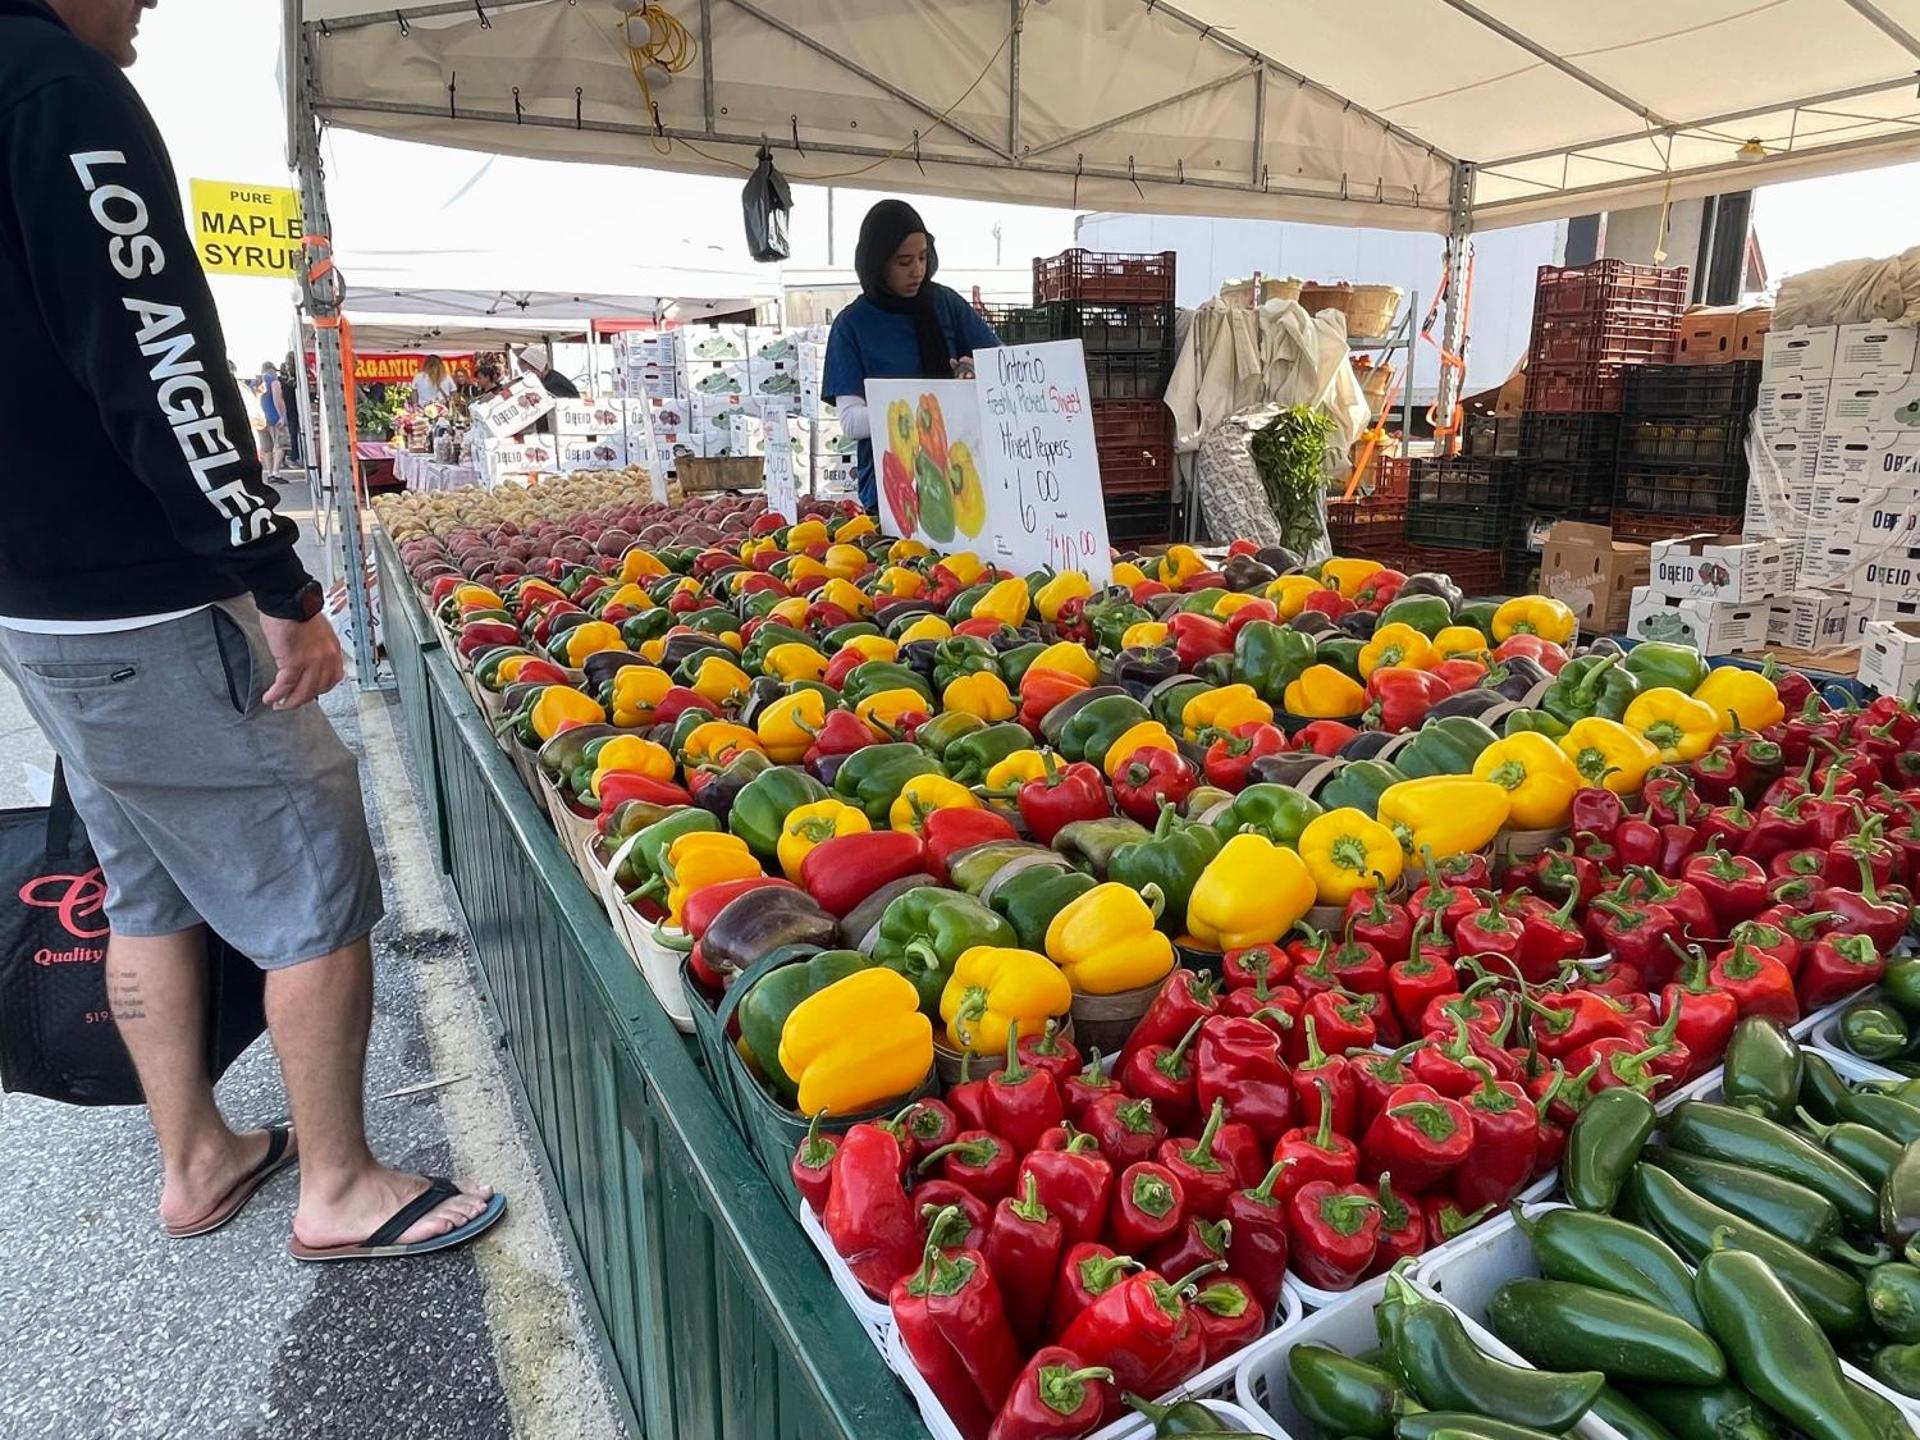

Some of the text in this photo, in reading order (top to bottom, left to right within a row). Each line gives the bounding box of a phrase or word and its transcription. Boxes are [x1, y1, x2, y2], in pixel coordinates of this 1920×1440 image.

[230, 191, 272, 204] PURE
[201, 211, 303, 239] MAPLE
[69, 150, 277, 547] LOS ANGELES
[355, 359, 418, 377] RGANIC
[998, 349, 1045, 386] Ontario
[1016, 384, 1048, 414] Picked
[1049, 385, 1081, 414] Sweet
[999, 421, 1072, 466] Mixed Peppers
[1659, 562, 1694, 584] OBEID
[34, 946, 104, 966] Quality
